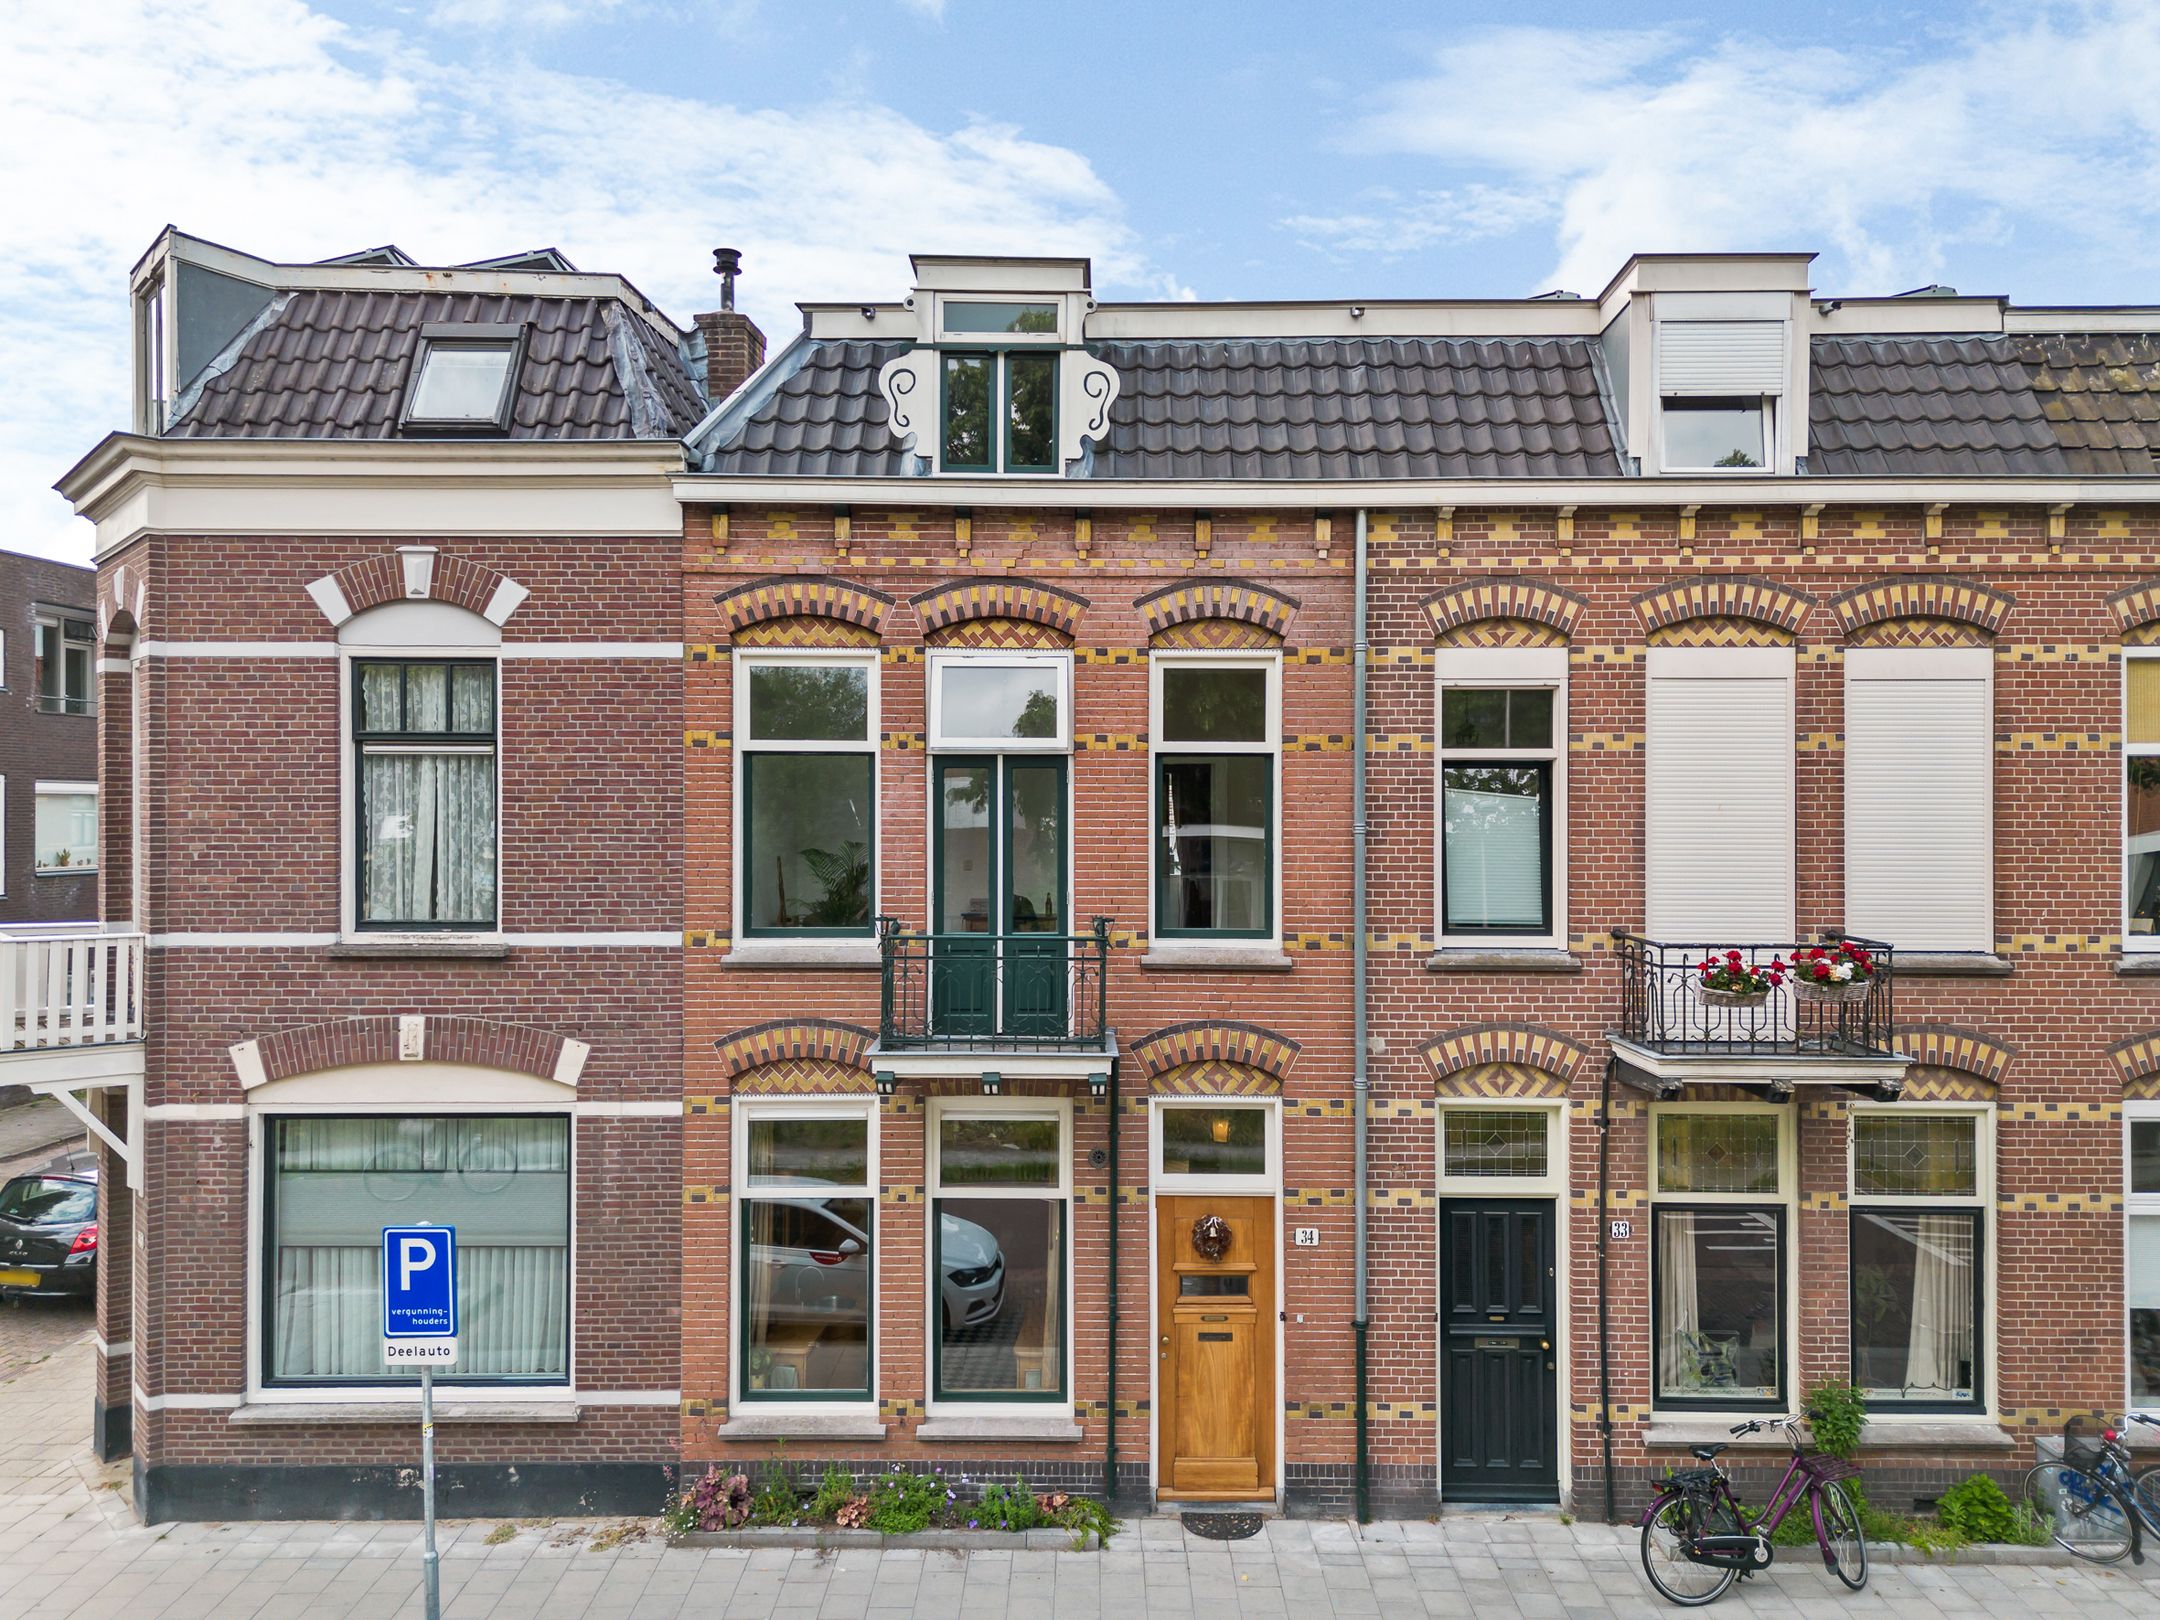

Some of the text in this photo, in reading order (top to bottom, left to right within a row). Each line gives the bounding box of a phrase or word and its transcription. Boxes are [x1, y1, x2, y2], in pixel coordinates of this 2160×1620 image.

[1613, 1222, 1627, 1237] 33
[1301, 1230, 1314, 1244] 34
[400, 1238, 436, 1291] P
[391, 1307, 448, 1316] vergunning-
[412, 1317, 448, 1325] houders
[387, 1345, 451, 1357] Deelauto
